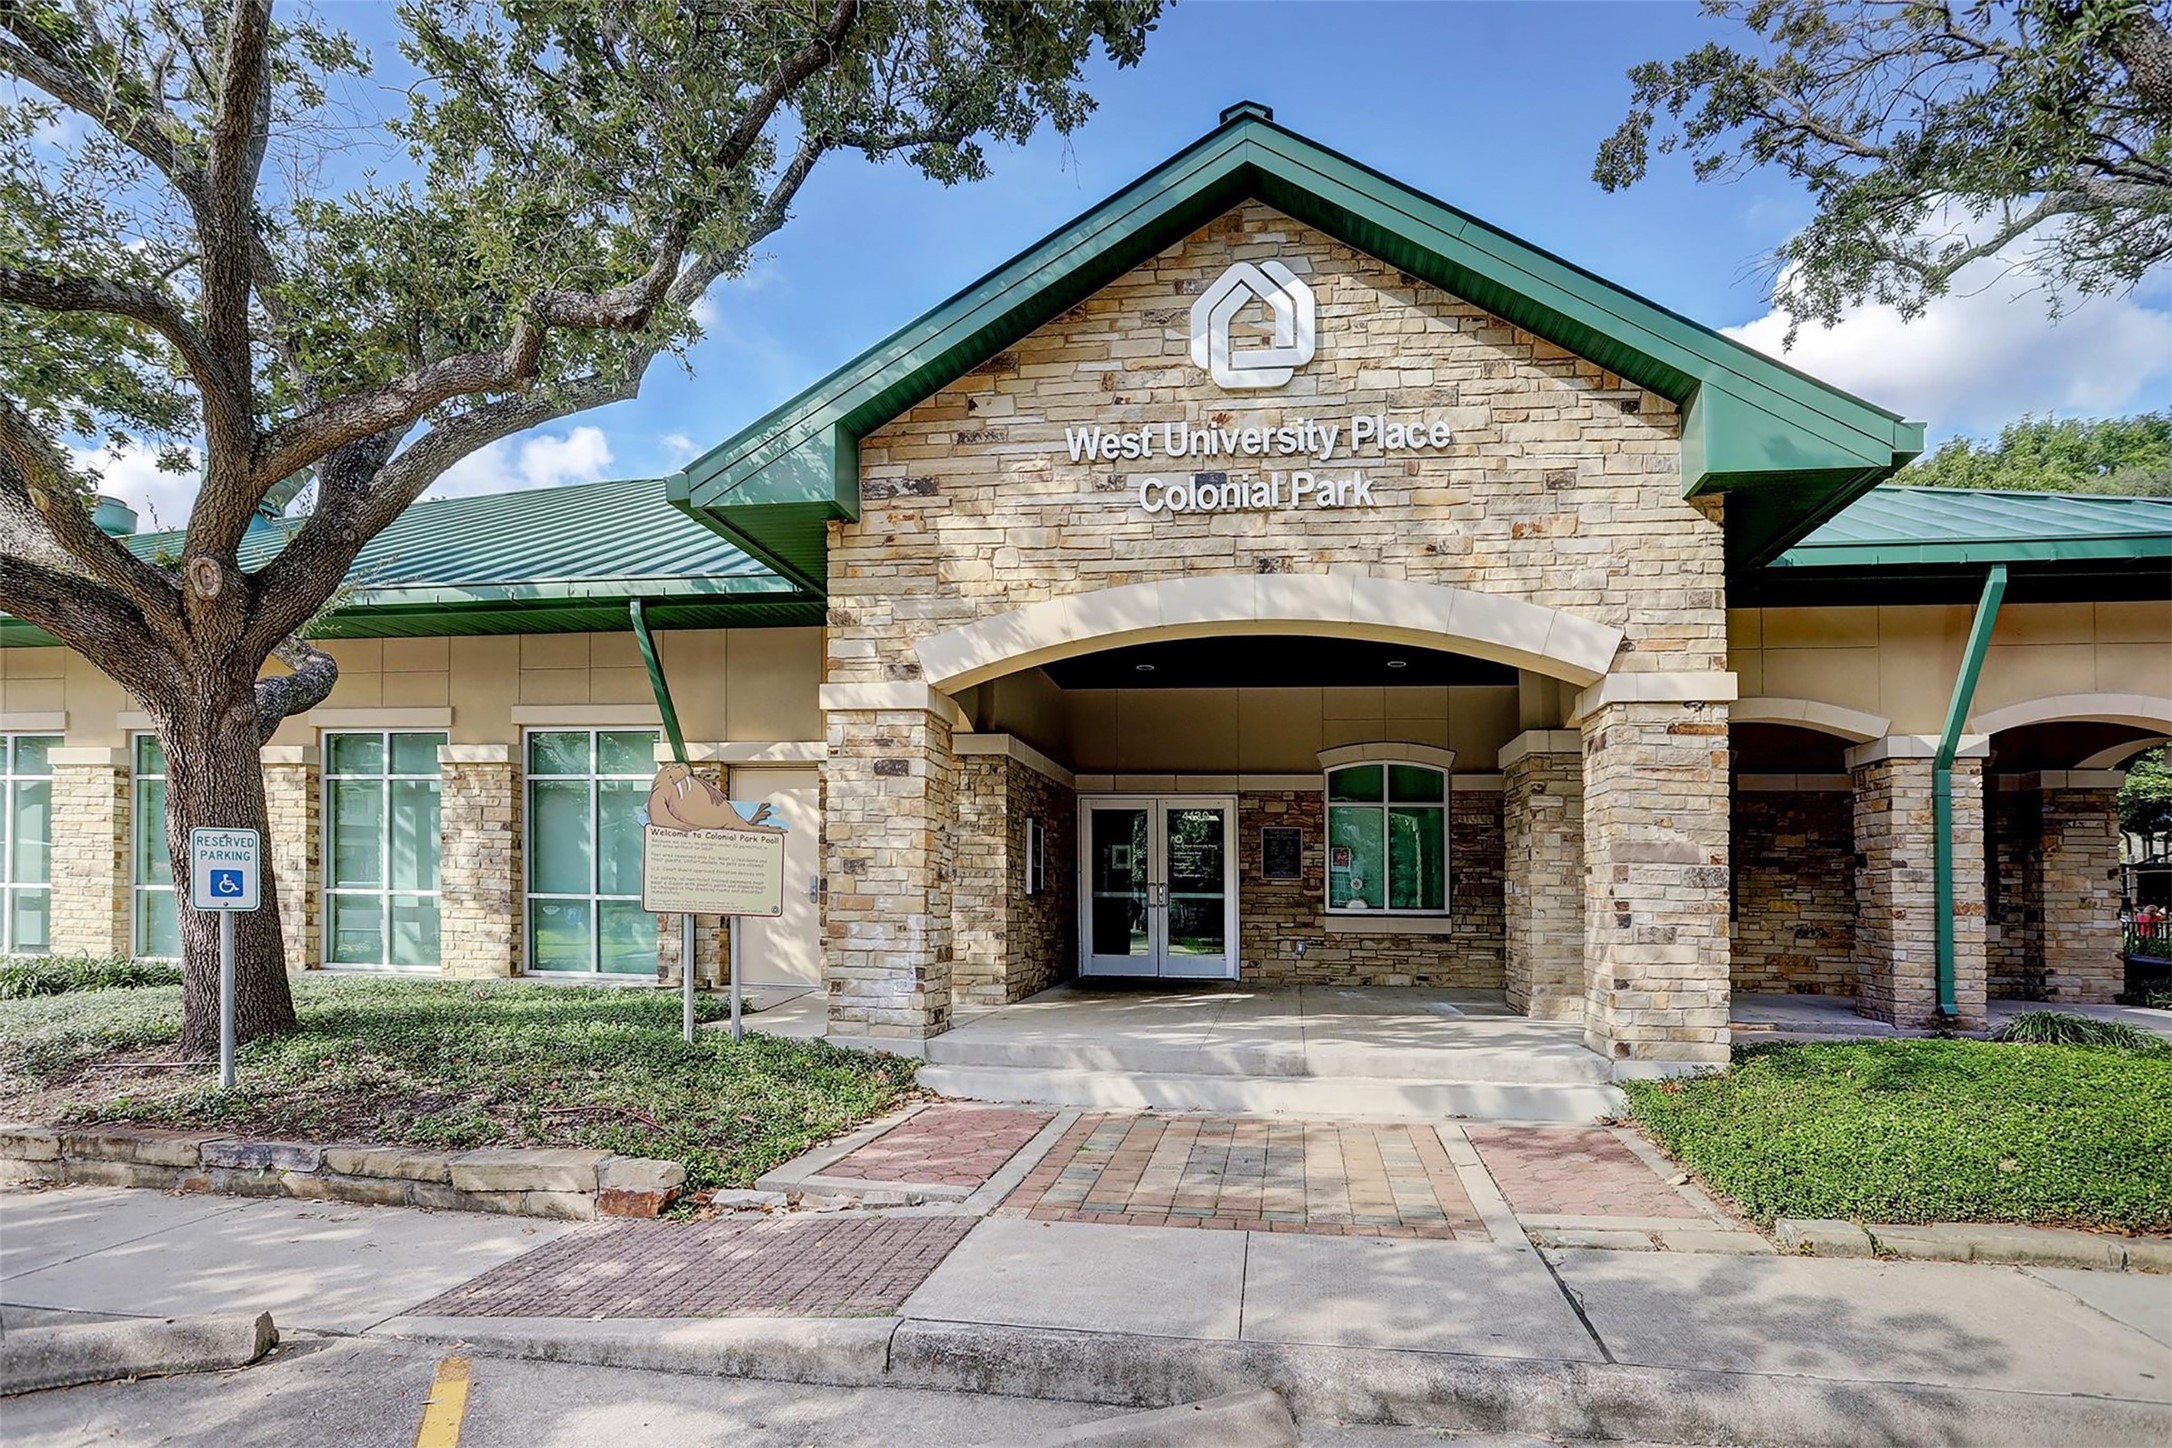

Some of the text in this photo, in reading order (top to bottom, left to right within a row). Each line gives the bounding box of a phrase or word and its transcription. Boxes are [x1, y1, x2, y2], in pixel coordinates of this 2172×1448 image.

[1065, 415, 1451, 462] West University Place
[1138, 470, 1375, 513] Colonial Park
[196, 836, 255, 861] RESERVED PARKING
[650, 828, 689, 838] Welcome
[693, 831, 702, 839] to
[705, 831, 737, 842] Colonial
[740, 833, 758, 842] Park
